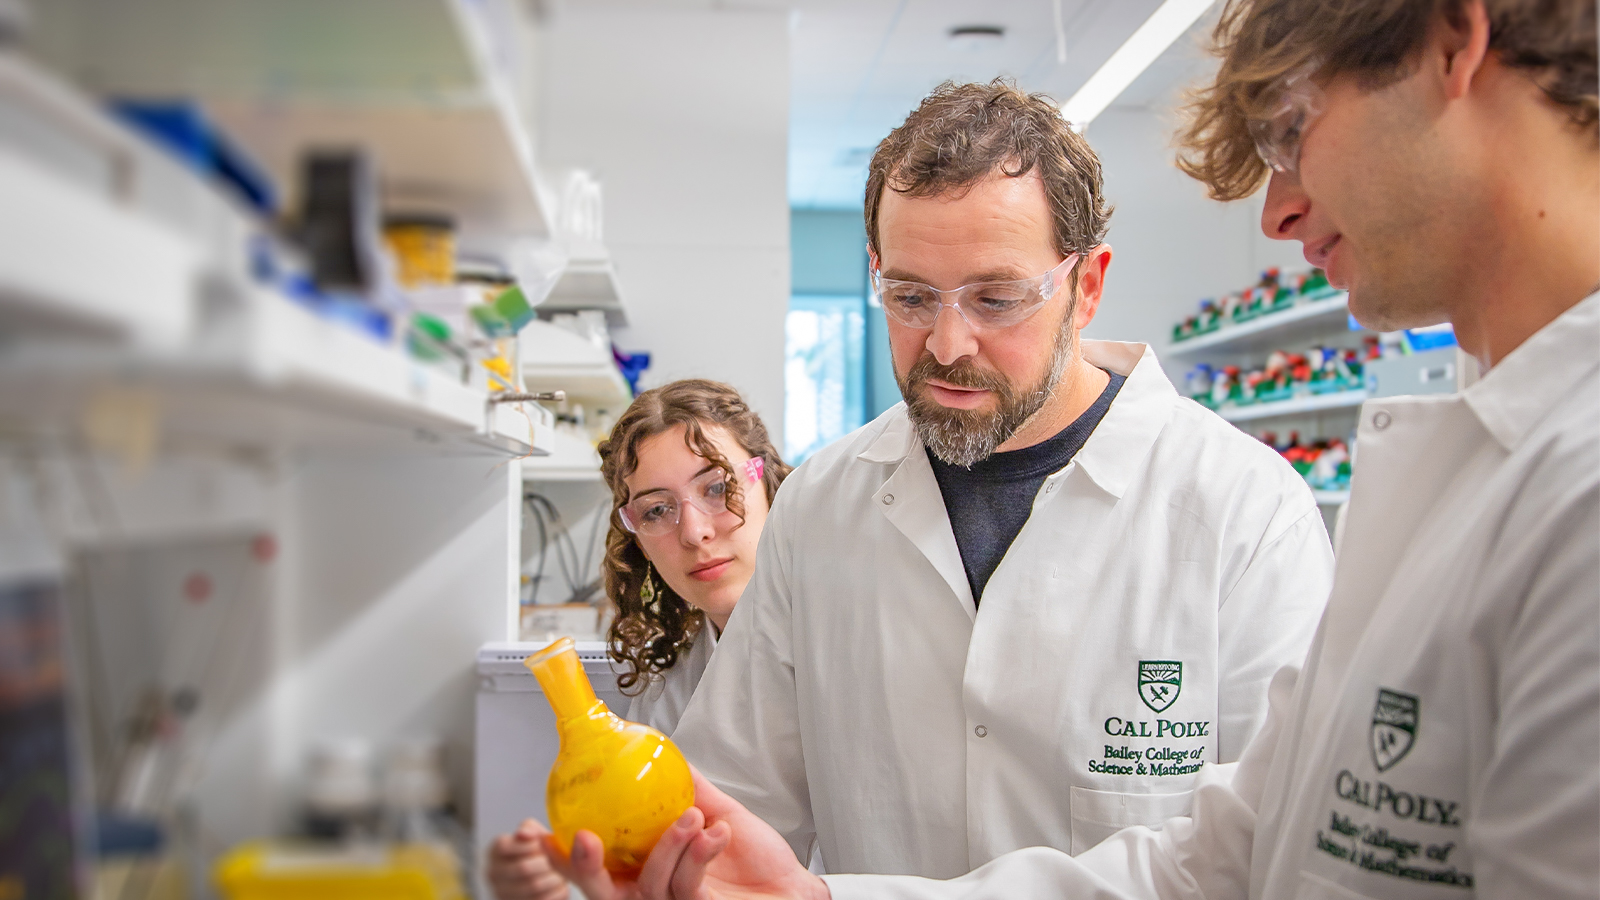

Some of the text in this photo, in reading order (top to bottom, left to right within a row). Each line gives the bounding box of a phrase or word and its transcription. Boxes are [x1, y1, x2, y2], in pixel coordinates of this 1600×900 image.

[1104, 716, 1152, 738] CAL
[1103, 744, 1205, 764] Bailey College of
[1088, 759, 1133, 776] Science
[1135, 762, 1148, 775] &
[1425, 842, 1456, 864] of
